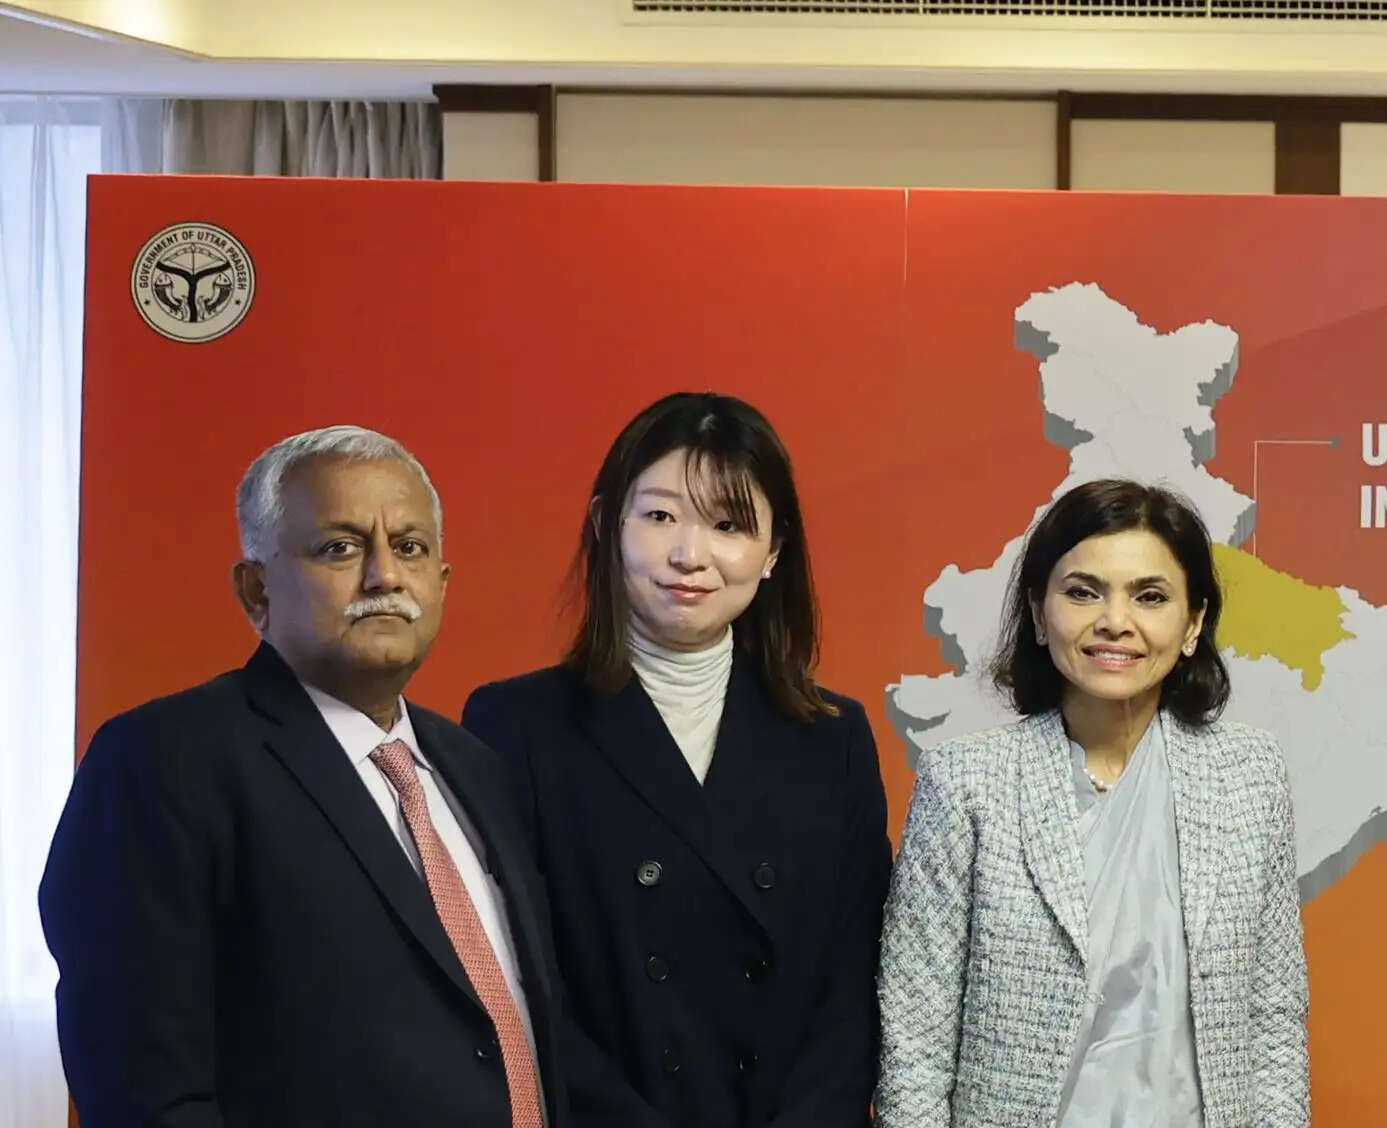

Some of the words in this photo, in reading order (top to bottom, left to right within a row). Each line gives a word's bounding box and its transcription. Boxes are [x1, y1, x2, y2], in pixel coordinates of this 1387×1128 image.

[139, 233, 179, 289] GOVERNMENT
[181, 230, 194, 241] OF
[197, 230, 228, 249] UTTAR
[225, 247, 247, 290] PRADESH
